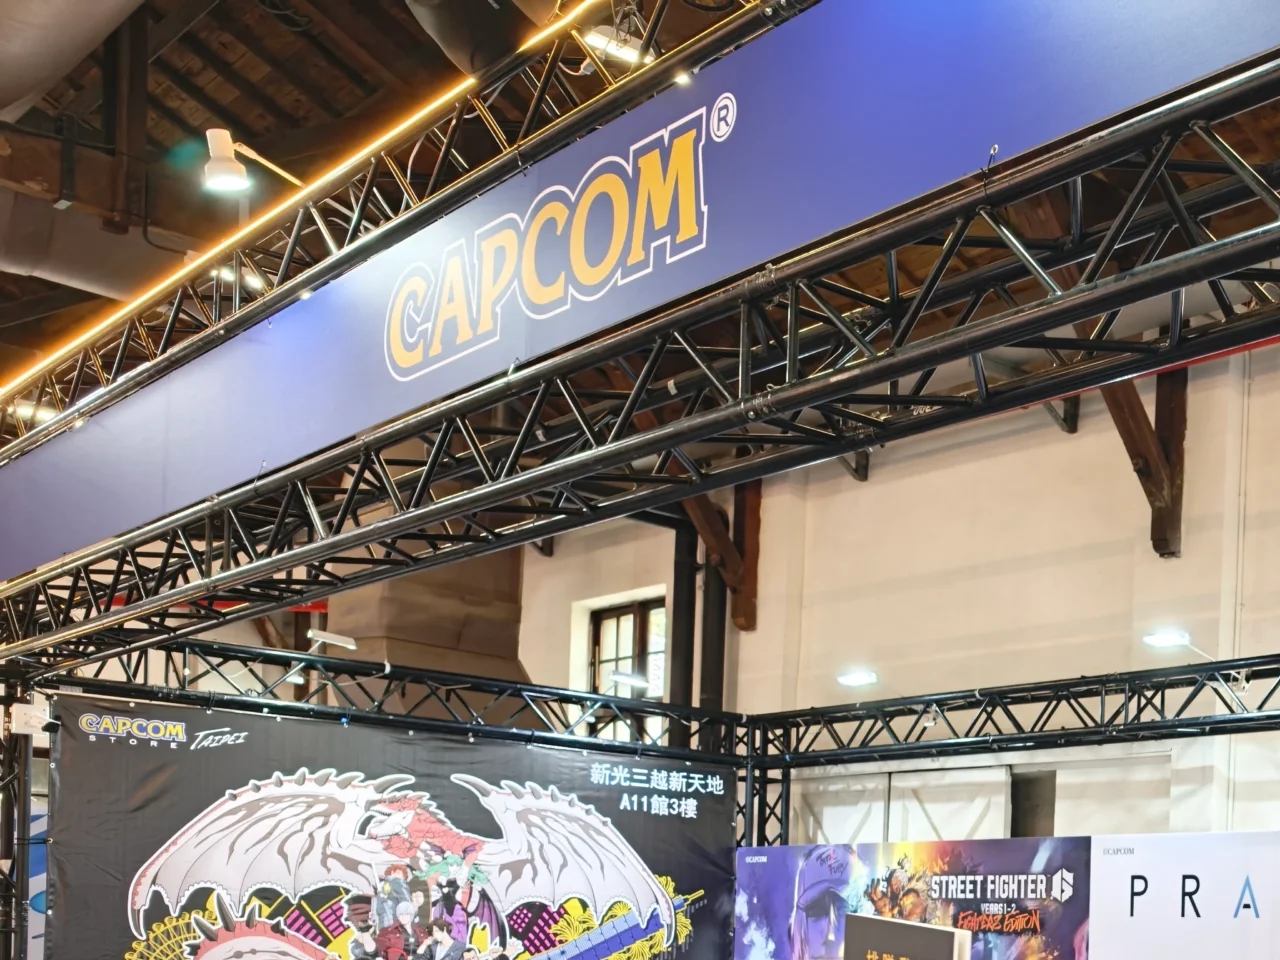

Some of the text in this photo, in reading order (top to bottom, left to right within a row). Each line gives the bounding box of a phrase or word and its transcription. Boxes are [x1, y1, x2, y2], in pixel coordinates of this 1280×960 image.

[385, 107, 707, 382] CAPCOM
[78, 713, 187, 742] CAPCOM
[88, 727, 249, 750] STORE TAIPEI
[590, 762, 725, 795] 新光三越新天地
[620, 793, 699, 819] A11館3樓
[931, 874, 984, 899] STREET
[987, 874, 1047, 899] FIGHTER
